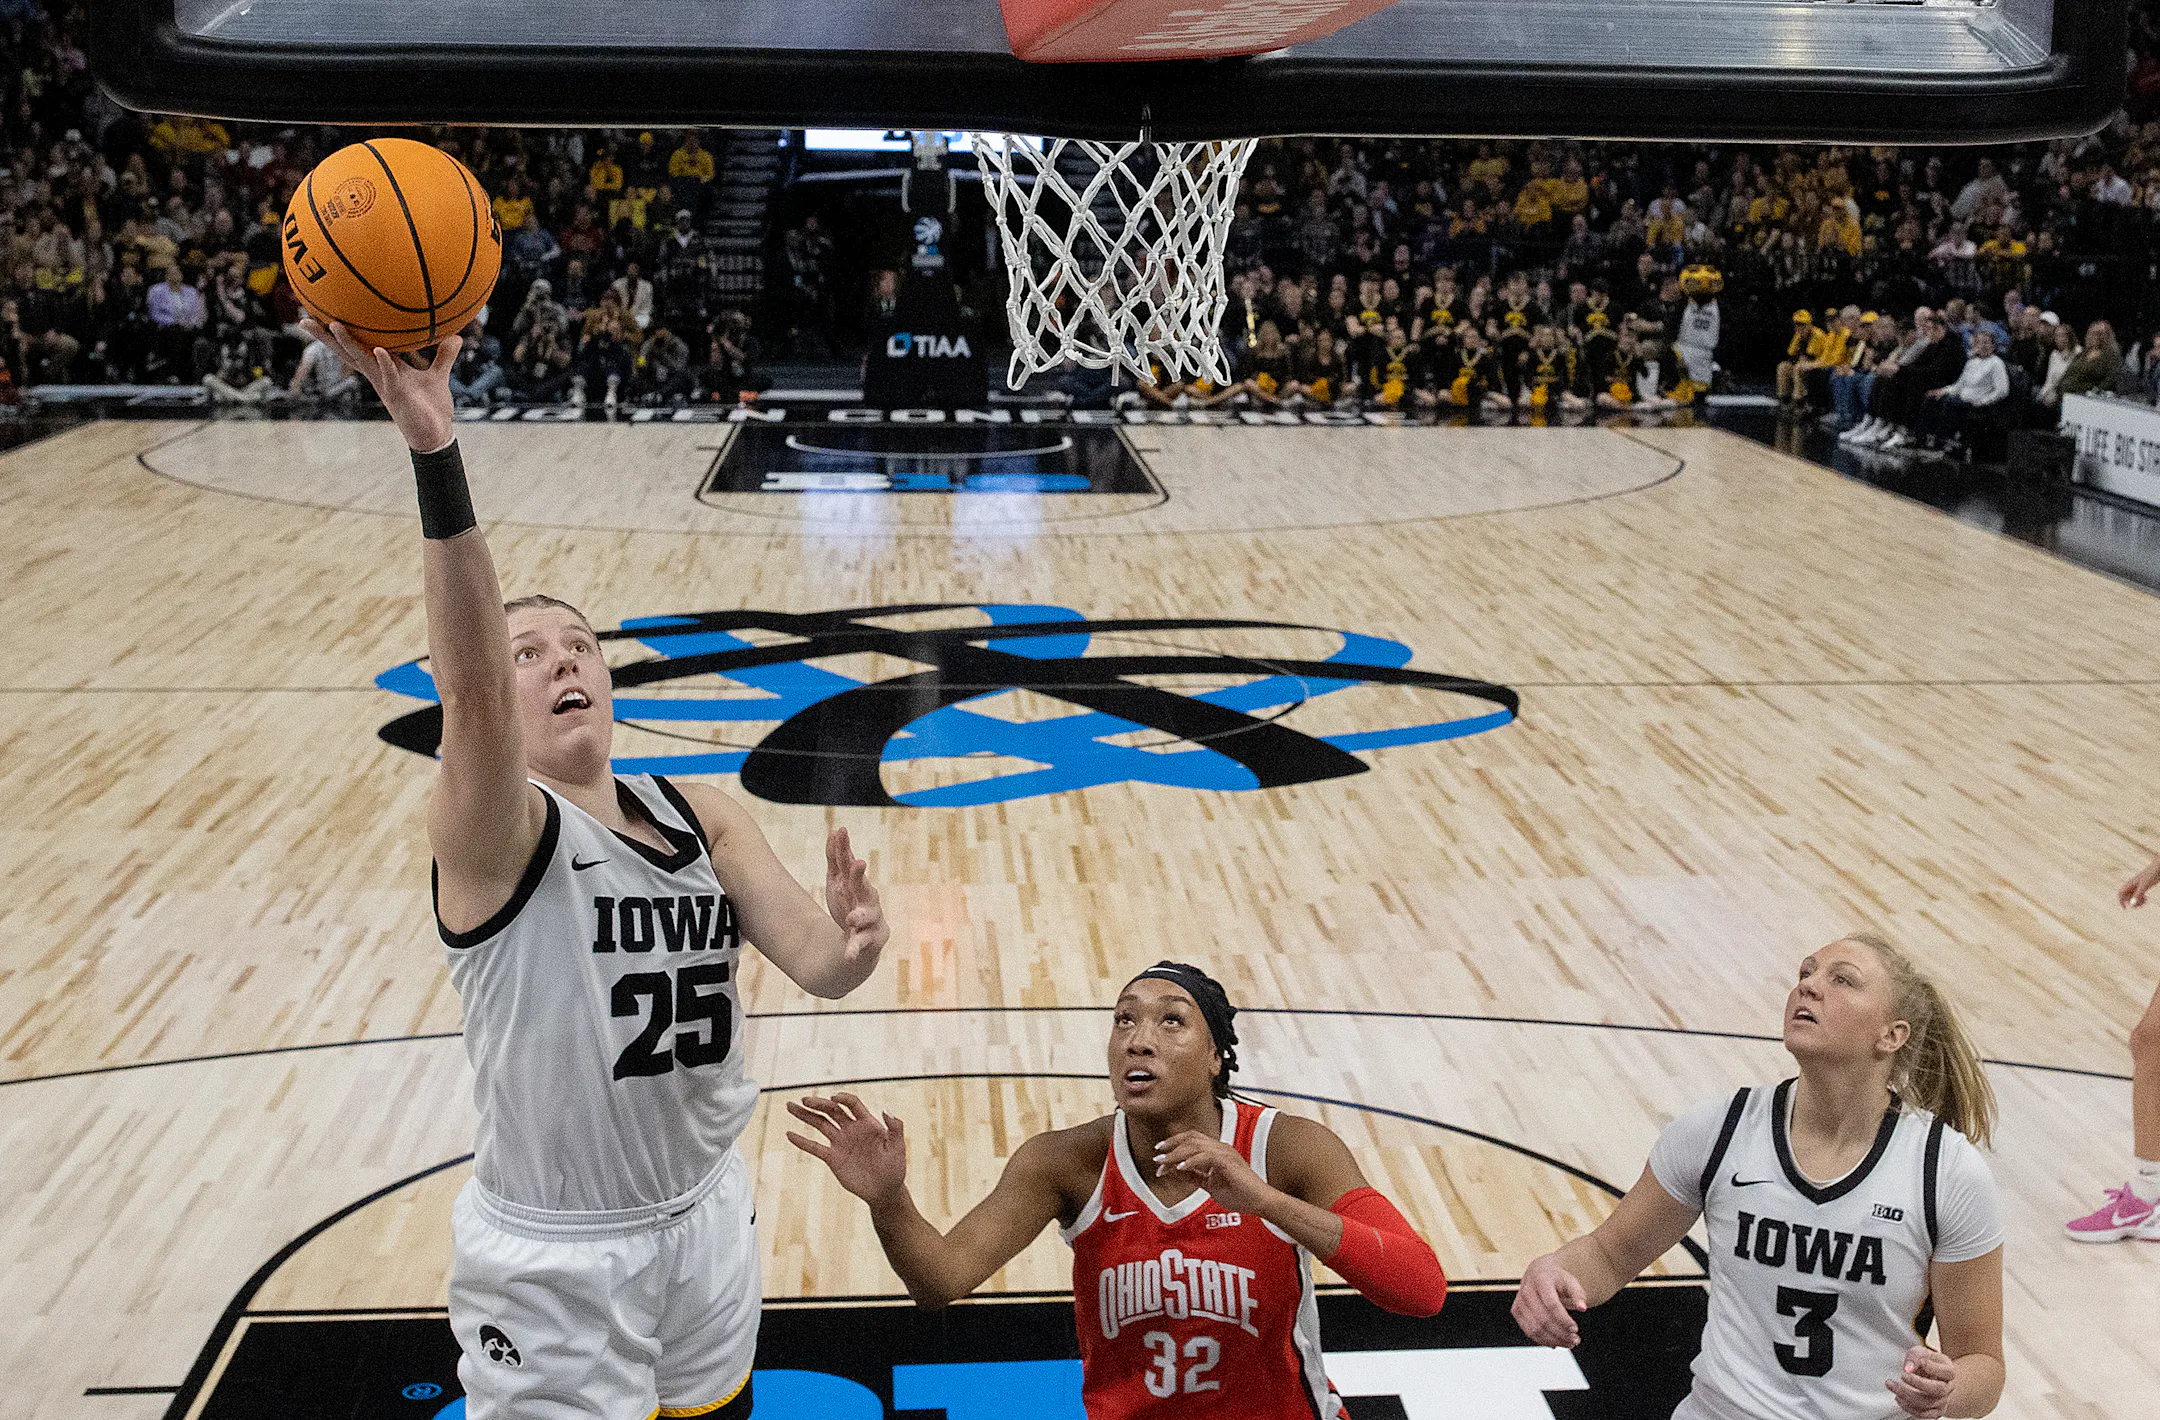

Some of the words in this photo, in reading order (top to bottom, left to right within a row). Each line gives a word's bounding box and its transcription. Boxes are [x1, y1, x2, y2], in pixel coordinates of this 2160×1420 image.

[912, 334, 972, 359] TIAA
[619, 406, 787, 423] TEN
[592, 893, 740, 954] IOWA
[610, 961, 733, 1082] 25
[1734, 1210, 1888, 1286] IOWA
[1143, 1330, 1221, 1398] 32
[1773, 1284, 1840, 1378] 3
